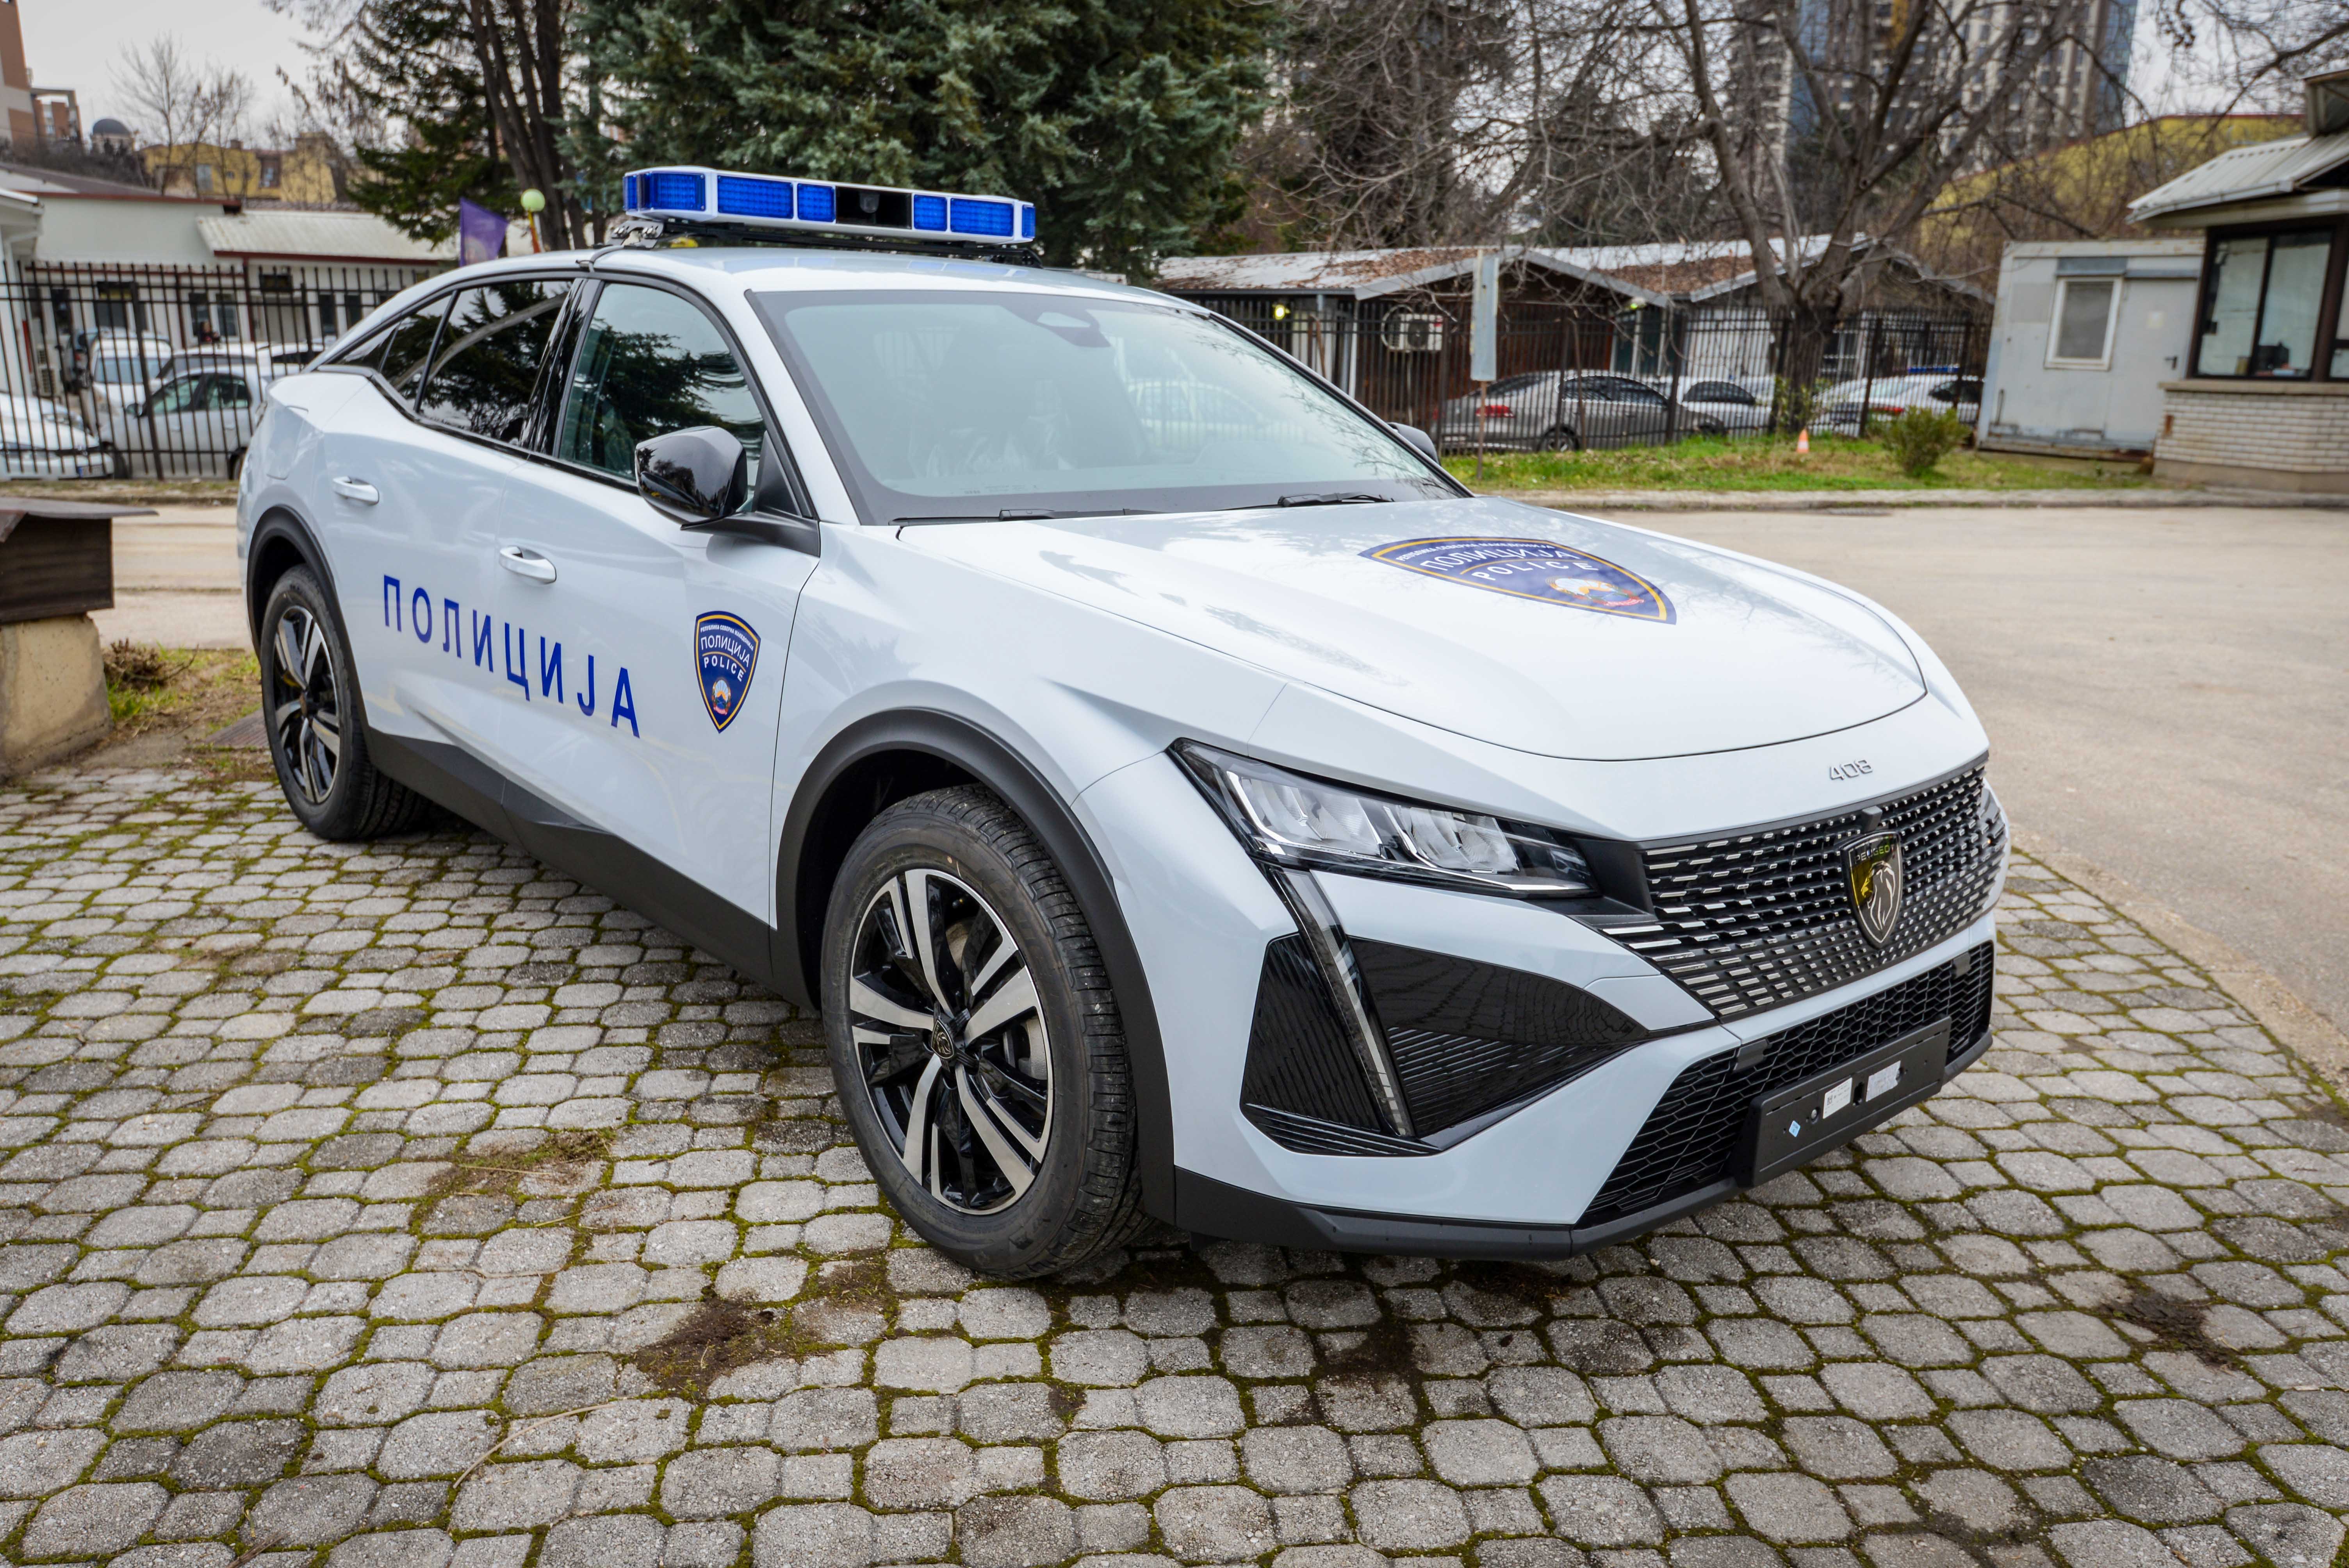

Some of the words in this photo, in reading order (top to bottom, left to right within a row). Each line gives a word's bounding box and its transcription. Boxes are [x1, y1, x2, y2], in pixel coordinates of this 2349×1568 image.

[1420, 549, 1581, 571] ПОЛИЦИЈА
[1471, 561, 1599, 581] POLICE
[383, 574, 640, 739] ПОЛИЦИЈА
[700, 635, 750, 668] ПОЛИЦИЈА
[704, 655, 744, 682] POLICE
[1830, 759, 1873, 780] 408
